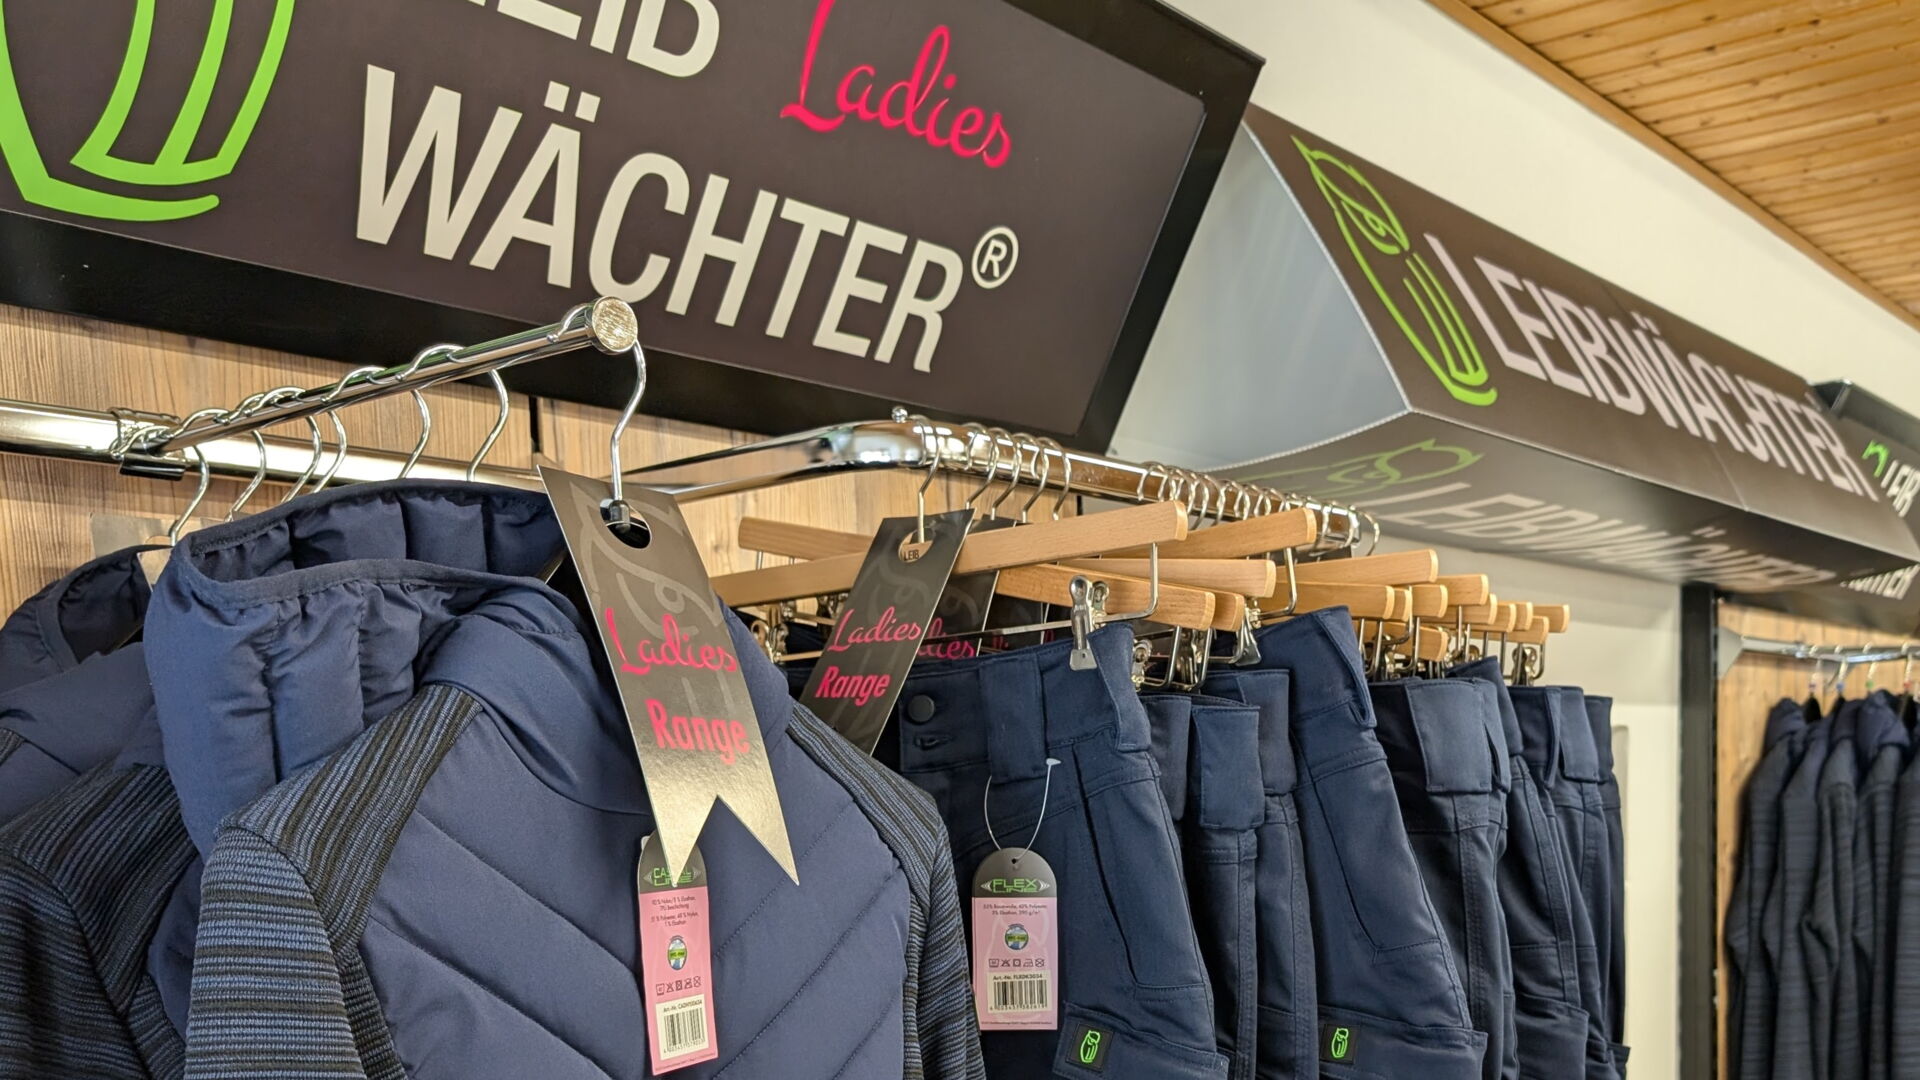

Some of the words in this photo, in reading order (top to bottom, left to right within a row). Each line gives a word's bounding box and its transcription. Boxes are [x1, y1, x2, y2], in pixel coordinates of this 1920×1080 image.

[779, 0, 1012, 168] Ladies
[1424, 233, 1879, 501] LEIBWÄCHTER
[605, 608, 737, 675] Ladies
[828, 607, 922, 652] Ladies
[816, 665, 891, 706] Range
[646, 698, 750, 765] Range
[993, 878, 1037, 888] FLEX
